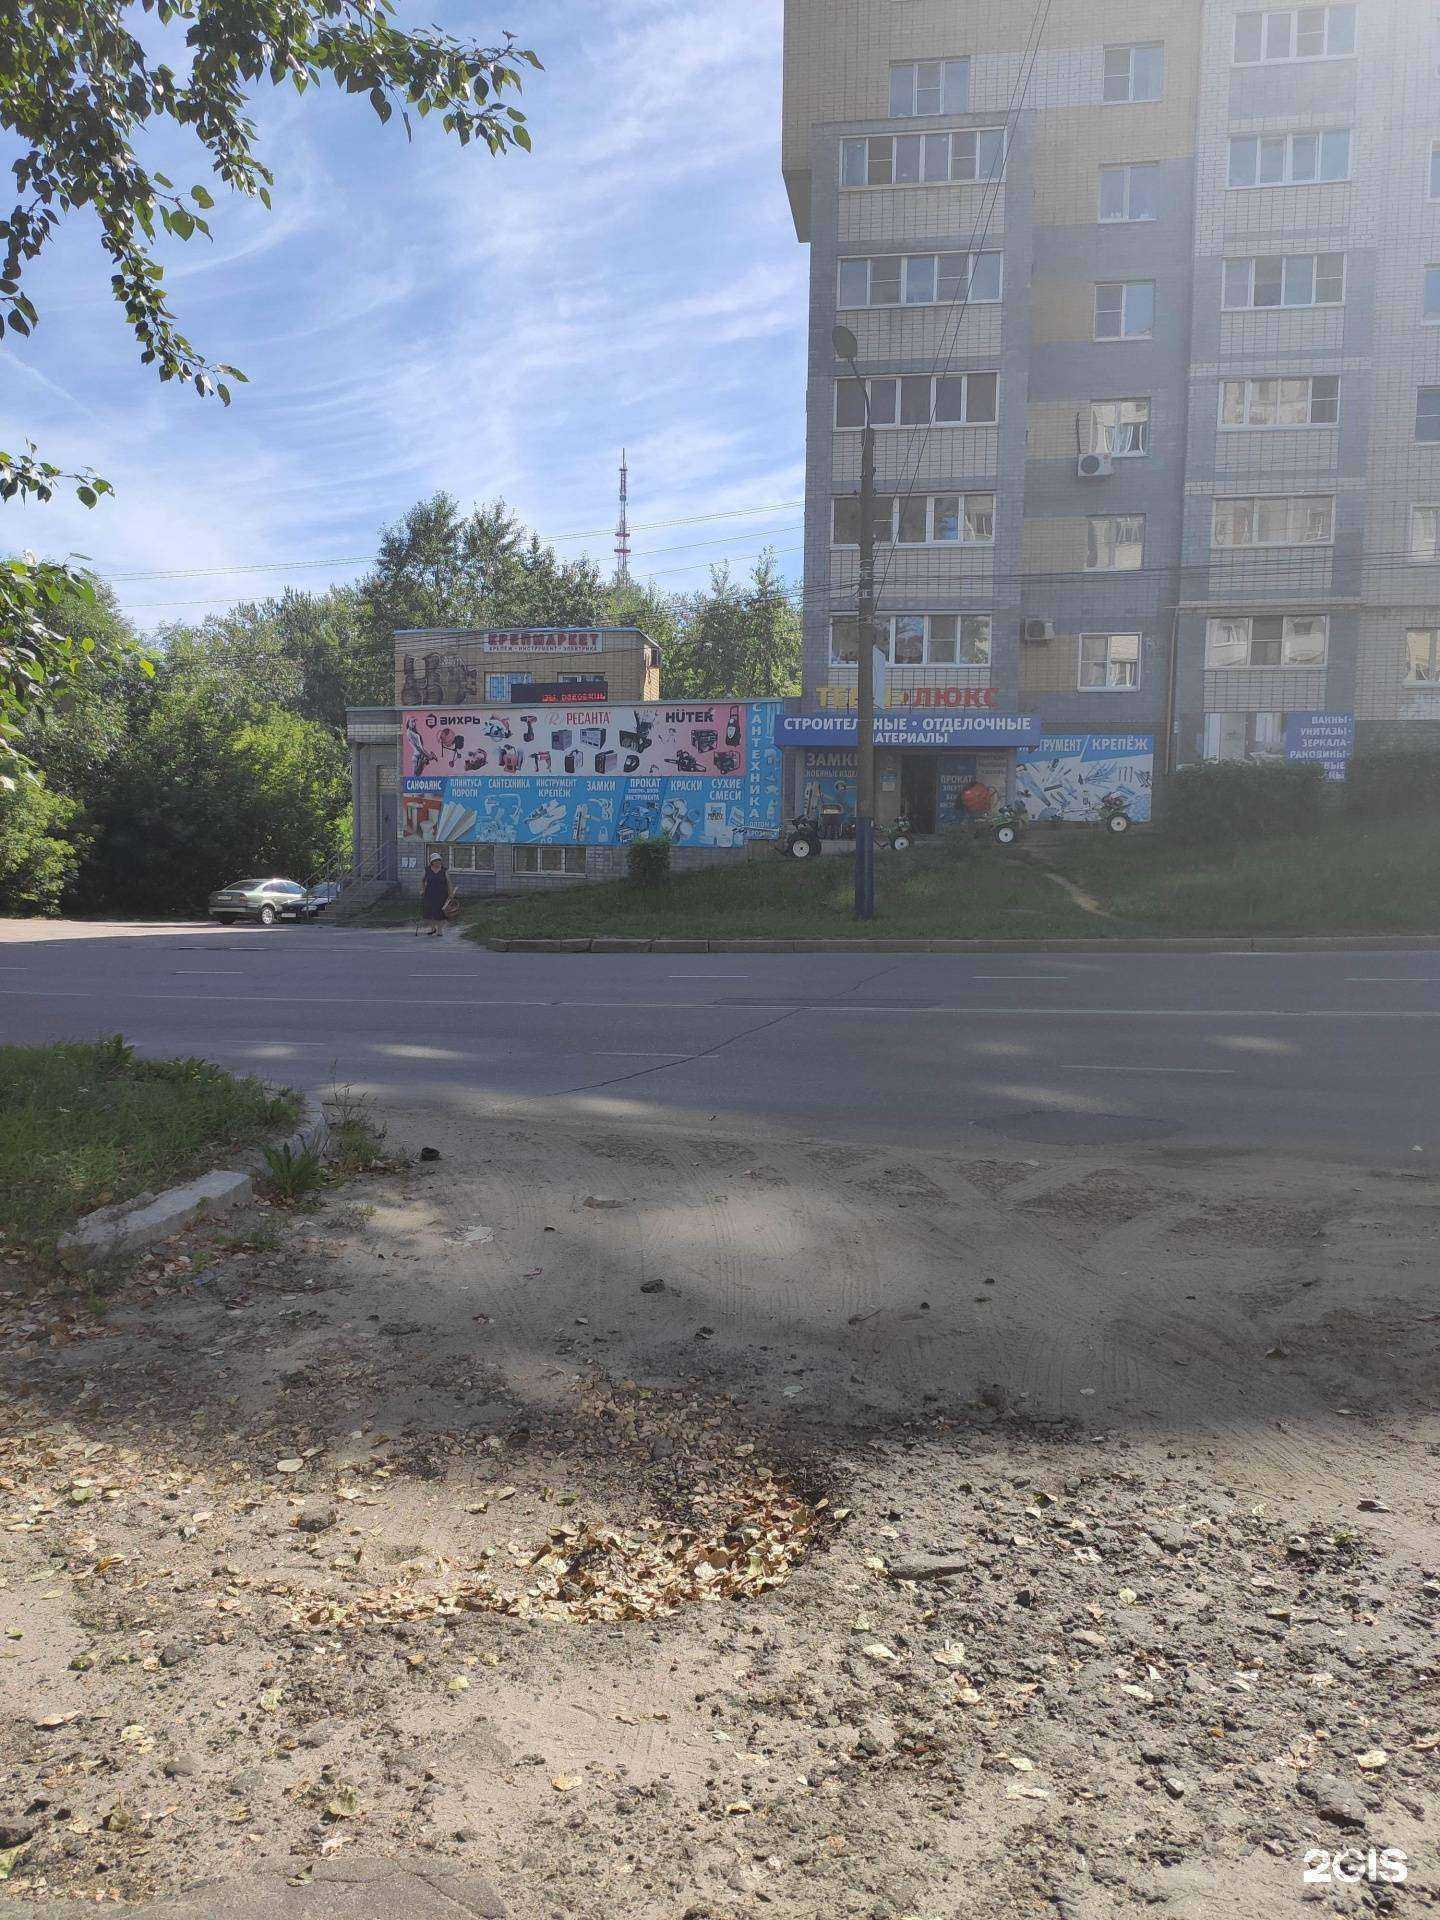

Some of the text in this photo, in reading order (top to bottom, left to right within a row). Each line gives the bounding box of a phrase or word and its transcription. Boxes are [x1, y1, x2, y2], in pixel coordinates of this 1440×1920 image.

[440, 715, 481, 725] ВИХРЬ
[566, 712, 610, 724] РЕСАНТА
[665, 708, 714, 723] HÜTER
[783, 717, 1031, 732] СТРОИТЕЛНЫЕ ОТДЕЛОЧНЫЕ
[873, 732, 948, 743] АТЕРИАЛЫ
[1092, 735, 1148, 751] КРЕПЁЖ
[749, 704, 762, 818] САНТЕХНИКА
[450, 778, 482, 787] ПЛИНТУСА
[488, 778, 530, 788] САНТЕХНИКА
[536, 778, 577, 787] ИНСТРУМЕНТ
[586, 780, 616, 791] ЗАМКИ
[630, 777, 661, 788] ПРОКАТ
[671, 780, 704, 791] КРАСКИ
[711, 778, 741, 789] СУХИЕ
[451, 788, 478, 797] ПОРОГИ
[709, 790, 741, 801] СМЕСИ
